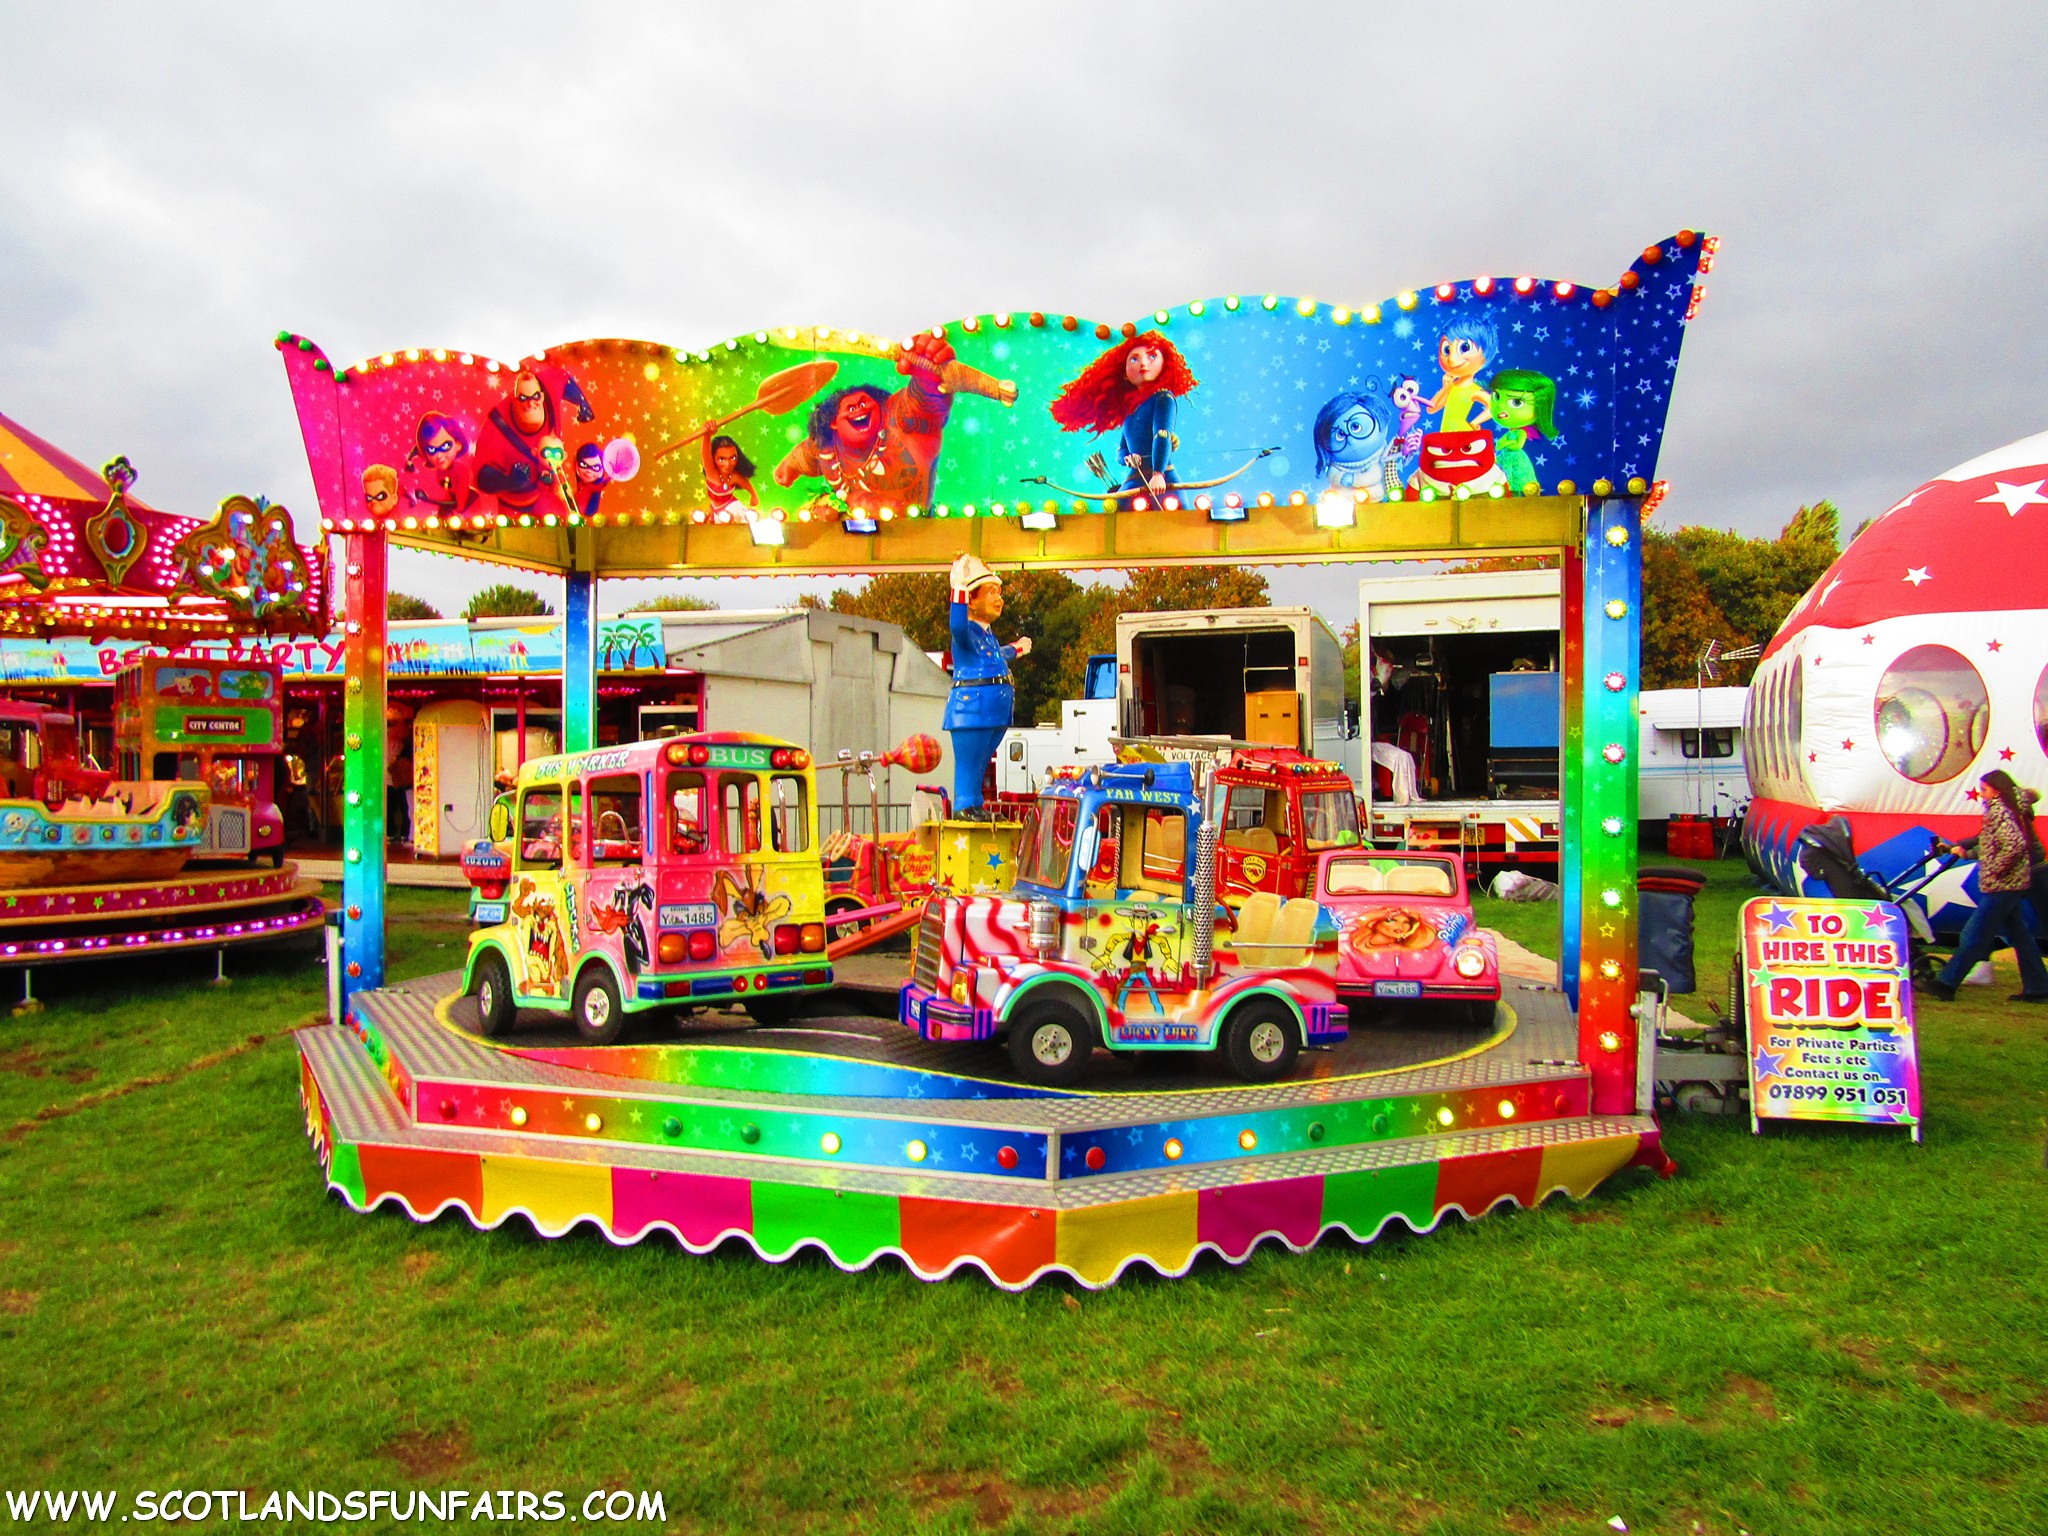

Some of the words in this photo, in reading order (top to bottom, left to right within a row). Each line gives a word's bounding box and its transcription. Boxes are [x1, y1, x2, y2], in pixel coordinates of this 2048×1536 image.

[189, 720, 207, 731] CITY
[209, 720, 240, 731] CENTRE
[710, 747, 766, 765] BUS
[535, 760, 562, 779] BUS
[1106, 787, 1135, 801] FAR
[1141, 789, 1181, 804] WEST
[465, 856, 502, 867] SUZUKI
[1807, 914, 1843, 935] TO
[1762, 941, 1825, 962] HIRE
[1833, 943, 1894, 965] THIS
[1769, 977, 1894, 1020] RIDE
[1121, 1026, 1159, 1041] LUCKY
[1164, 1025, 1198, 1041] LUKE
[1770, 1036, 1792, 1048] For
[1796, 1036, 1845, 1050] Private
[1849, 1038, 1896, 1052] Parties
[1784, 1066, 1840, 1081] Contact
[1843, 1070, 1859, 1081] us
[1769, 1083, 1828, 1100] 07899
[1833, 1086, 1866, 1103] 951
[1873, 1087, 1907, 1105] 051
